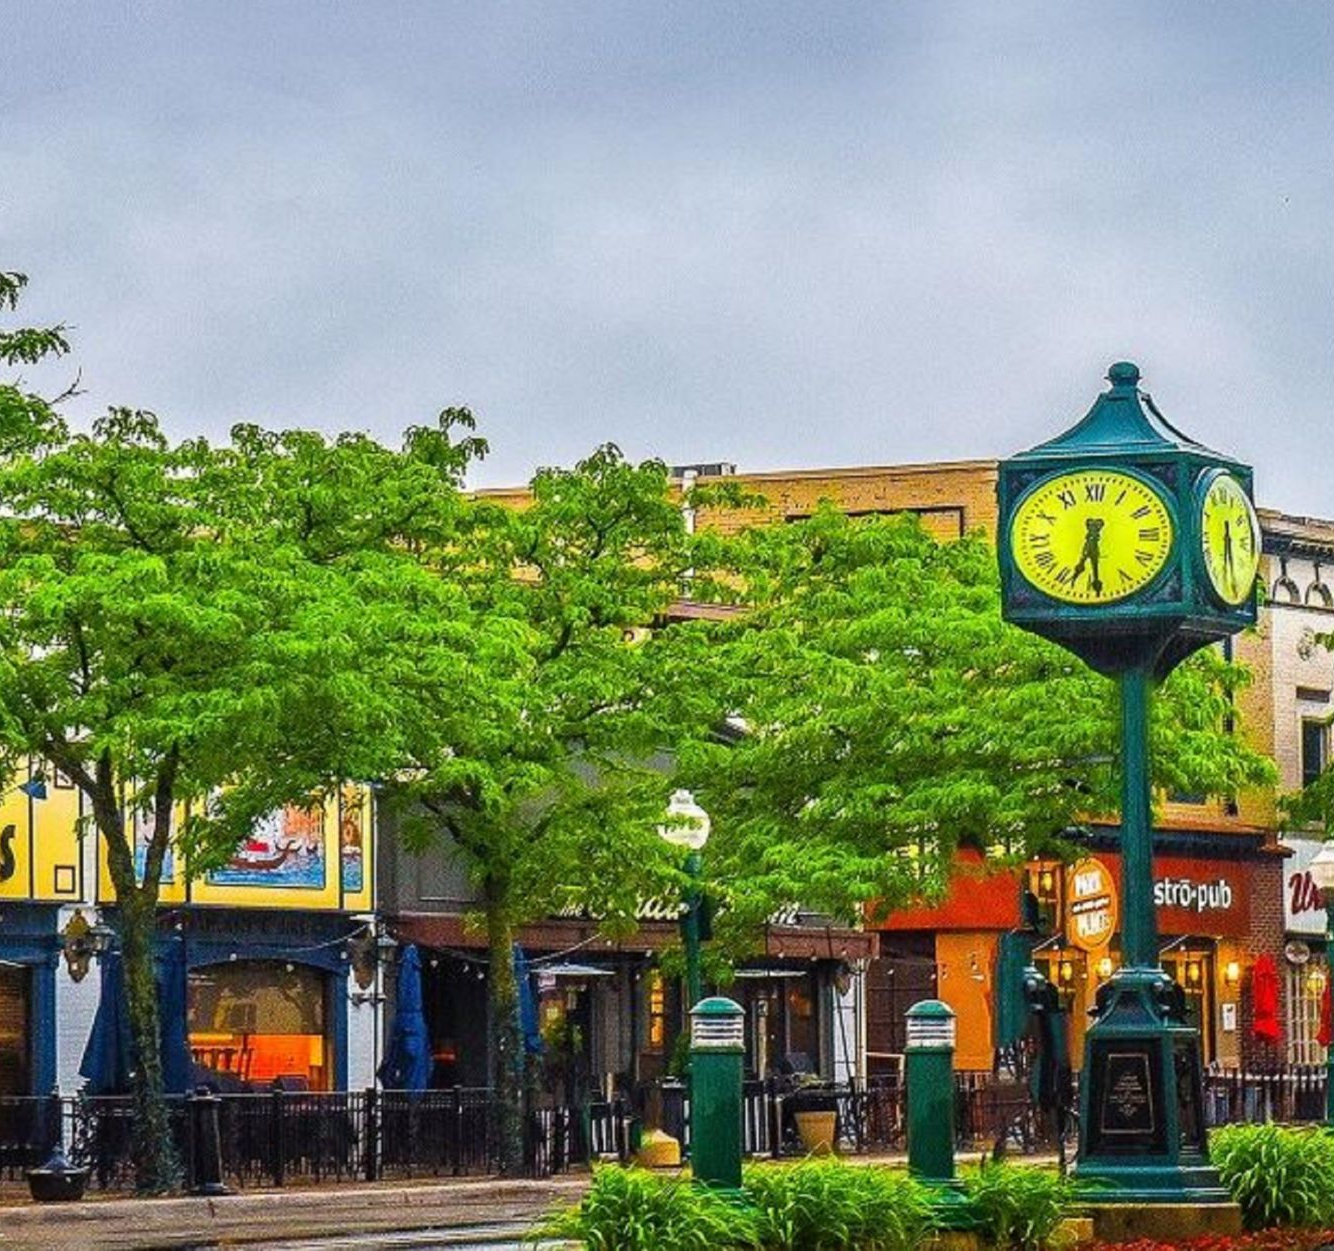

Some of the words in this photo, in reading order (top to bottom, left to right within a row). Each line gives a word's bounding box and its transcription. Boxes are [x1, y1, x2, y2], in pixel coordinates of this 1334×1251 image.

[1057, 490, 1076, 510] XI
[1086, 484, 1105, 502] XII
[1115, 490, 1127, 506] I
[1036, 510, 1056, 526] X
[1130, 505, 1152, 519] II
[1139, 527, 1160, 541] III
[1153, 876, 1232, 912] strō·pub
